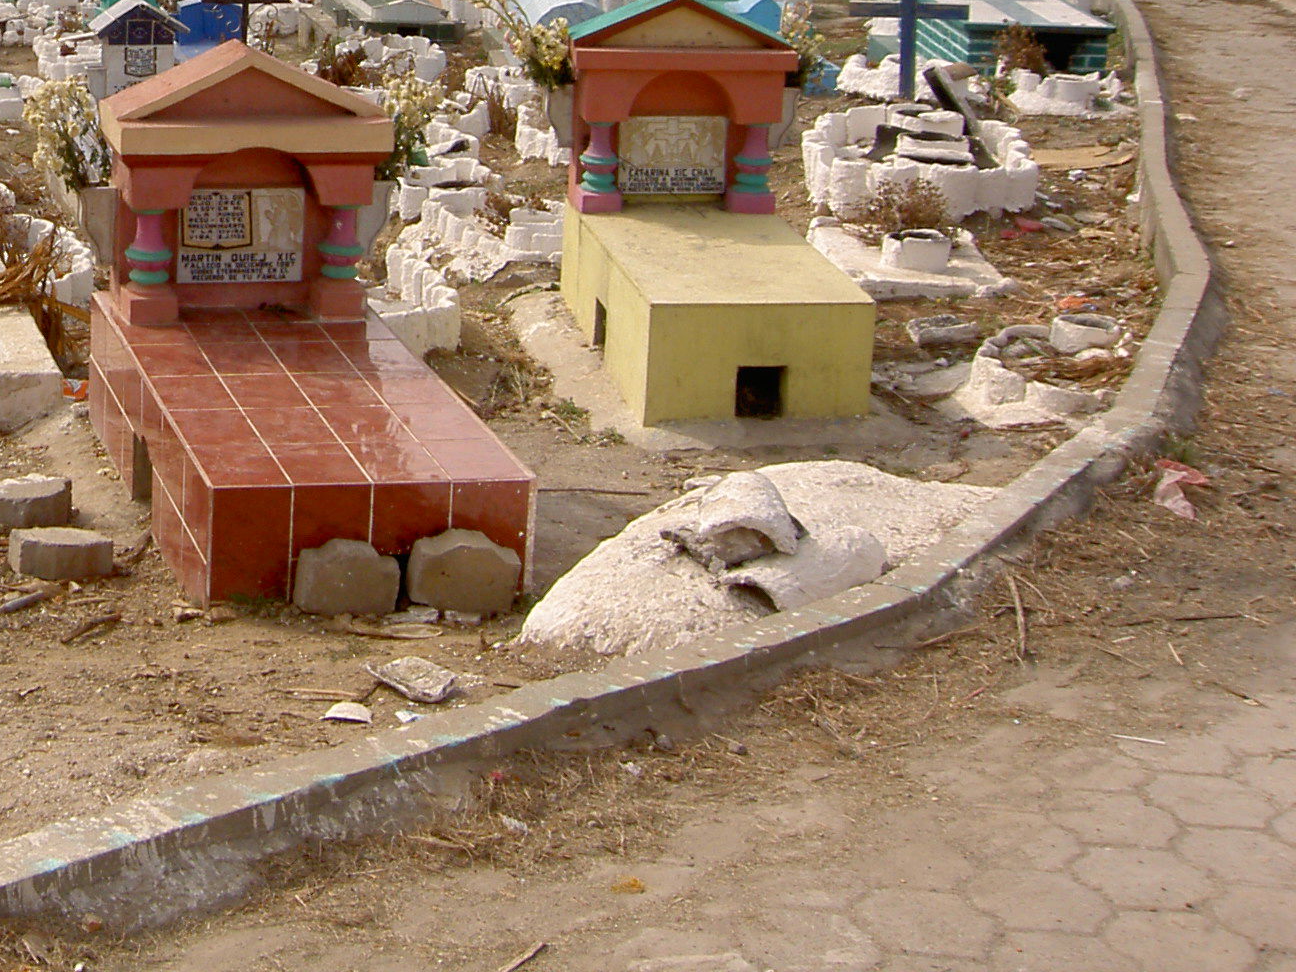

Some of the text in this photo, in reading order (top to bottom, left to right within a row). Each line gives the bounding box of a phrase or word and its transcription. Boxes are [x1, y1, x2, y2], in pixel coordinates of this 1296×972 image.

[628, 168, 714, 177] CATARINA XIC CHAY
[181, 252, 296, 262] MARTIN QUIEJ XIC
